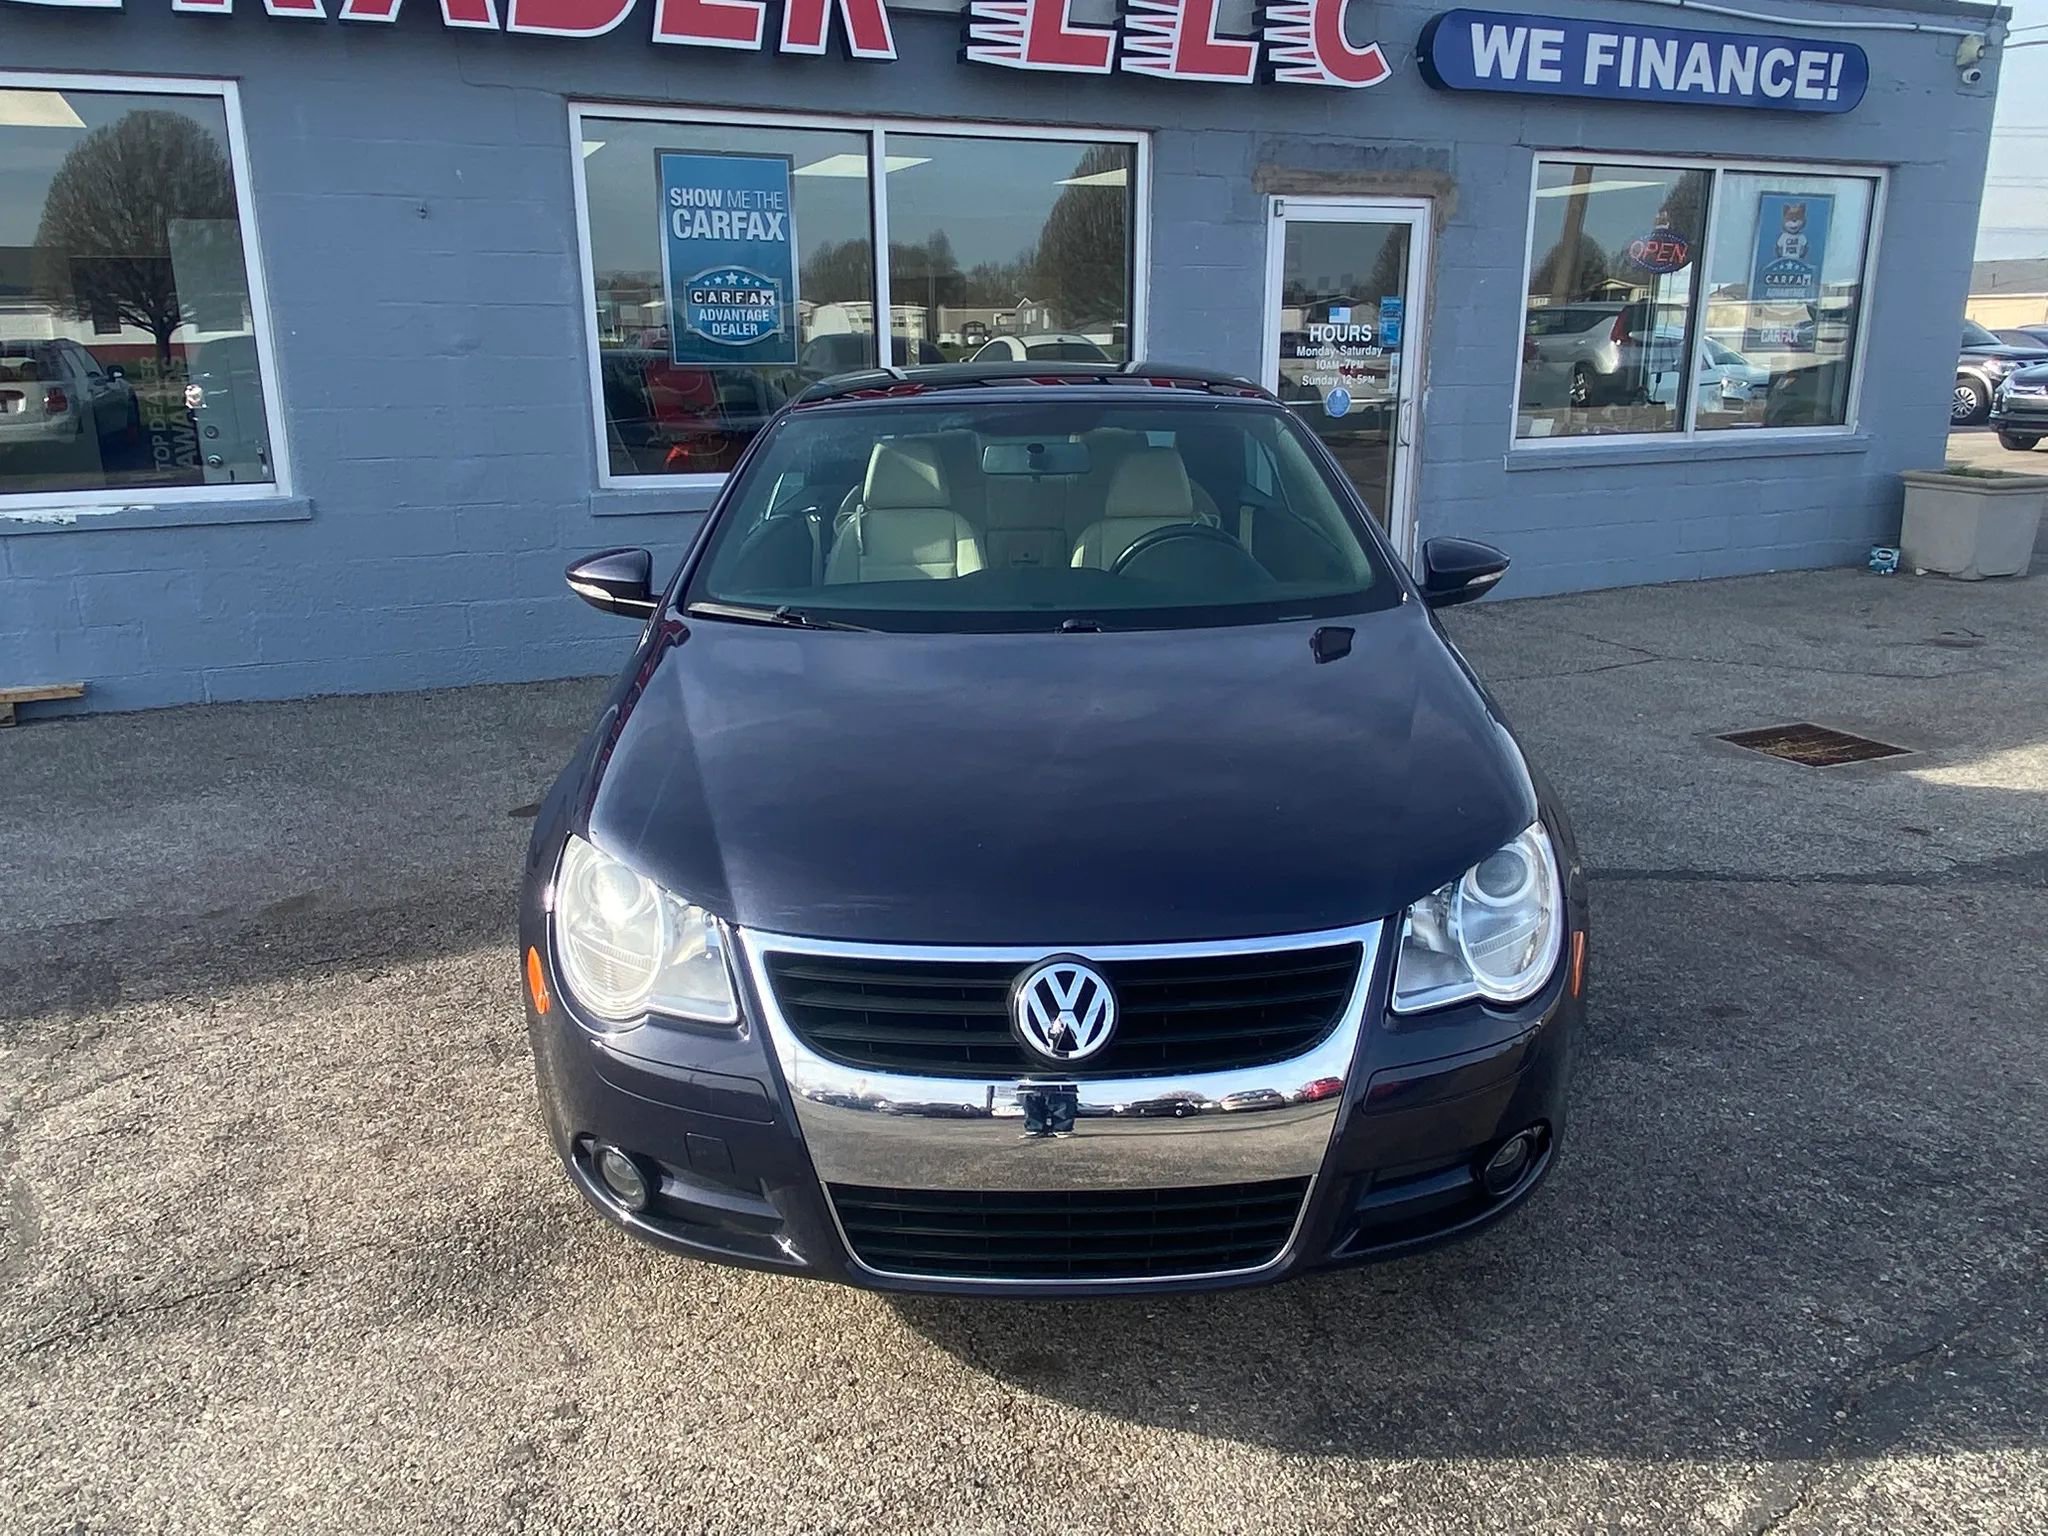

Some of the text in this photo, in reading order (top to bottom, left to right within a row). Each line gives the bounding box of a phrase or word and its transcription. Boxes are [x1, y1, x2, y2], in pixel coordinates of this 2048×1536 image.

[1470, 23, 1845, 101] WE FINANCE!
[670, 187, 784, 210] SHOW ME THE
[672, 208, 786, 241] CARFAX
[1629, 240, 1688, 264] OPEN
[692, 290, 774, 305] CARFAX
[699, 308, 770, 321] ADVANTAGE
[711, 322, 759, 336] DEALER
[1309, 323, 1373, 342] HOURS
[1296, 344, 1383, 358] Monday-Saturday
[1302, 375, 1339, 387] Sunday
[152, 435, 173, 471] TOP
